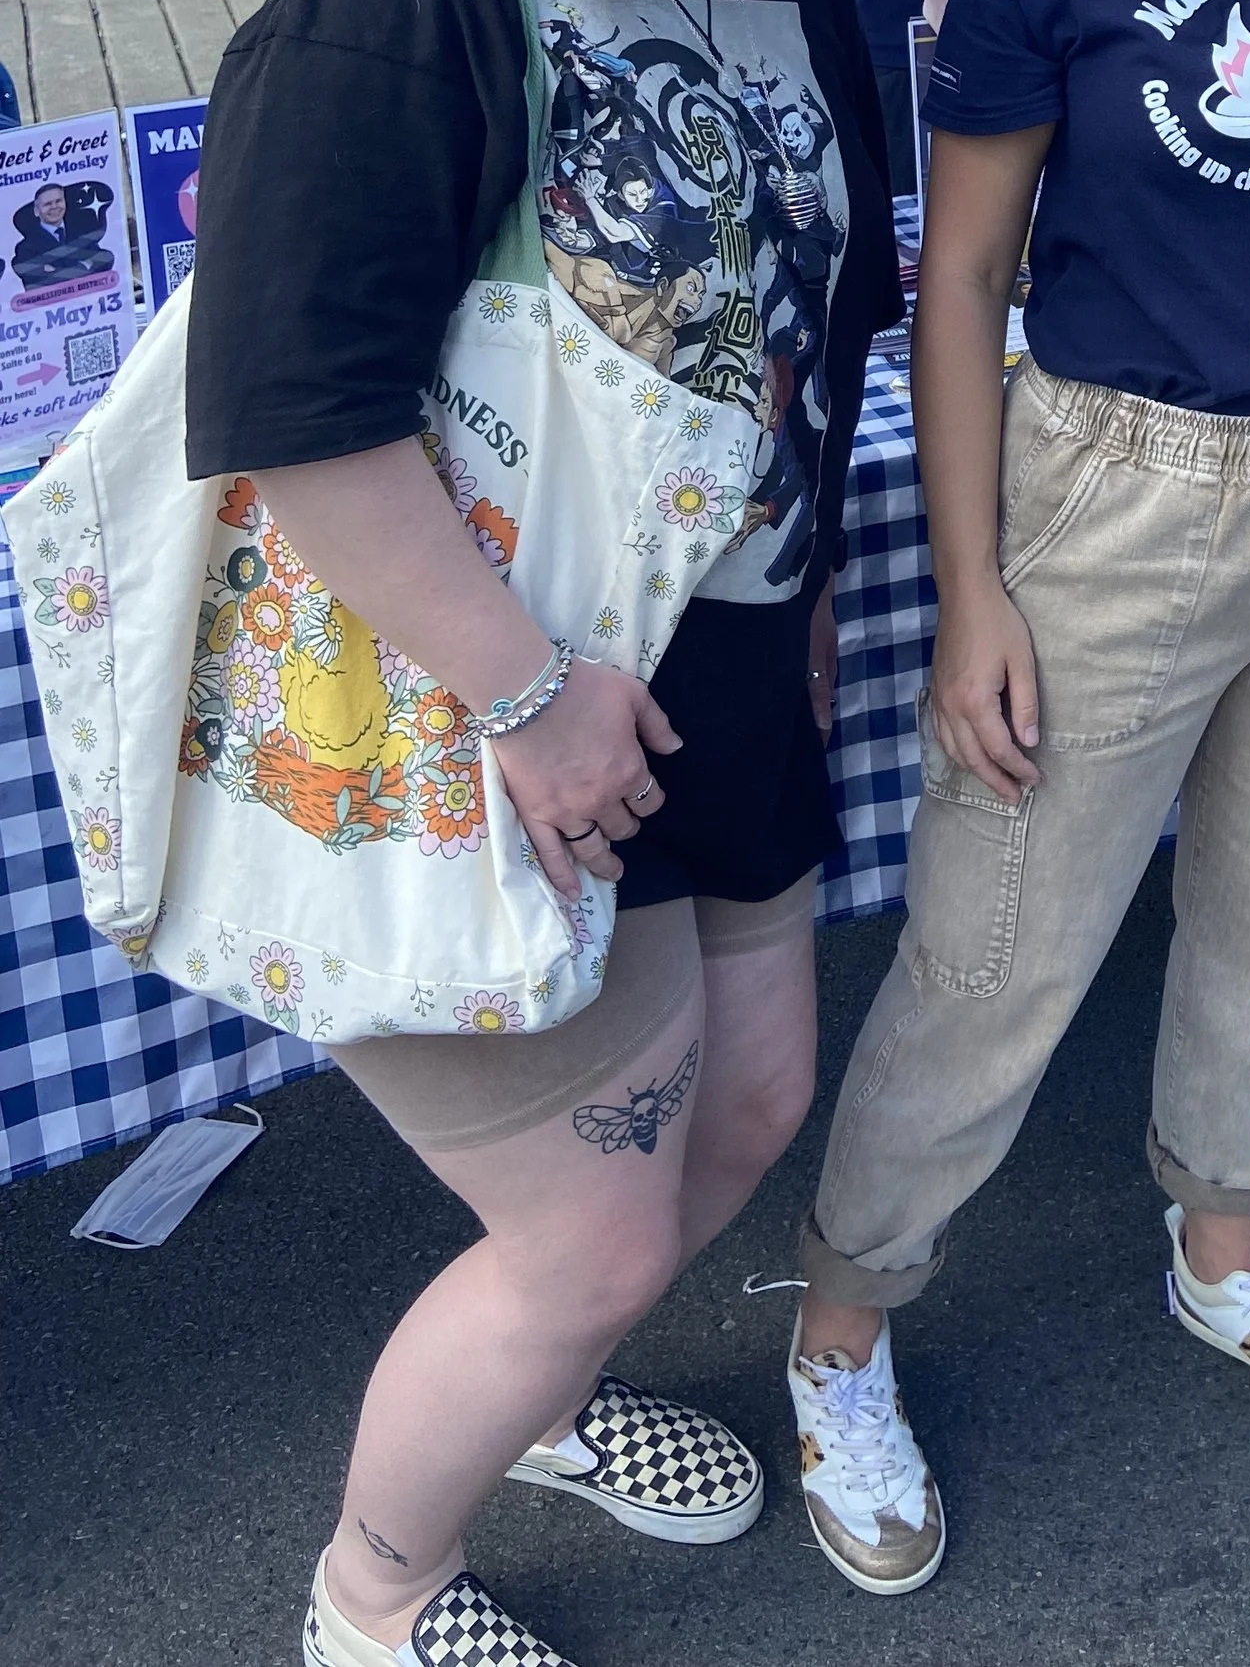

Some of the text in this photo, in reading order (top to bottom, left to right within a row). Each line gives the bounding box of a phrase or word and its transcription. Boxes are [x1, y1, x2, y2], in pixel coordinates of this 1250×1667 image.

[39, 139, 52, 162] &
[58, 130, 109, 156] Greet
[1142, 79, 1202, 168] Cooking
[1198, 156, 1232, 184] up
[55, 154, 109, 174] Mosley
[16, 286, 76, 307] CONGRESSIONAL
[77, 277, 109, 291] DISTRICT
[45, 305, 93, 329] May
[98, 291, 123, 315] 13
[1, 352, 42, 371] Suite 640
[33, 394, 66, 417] soft
